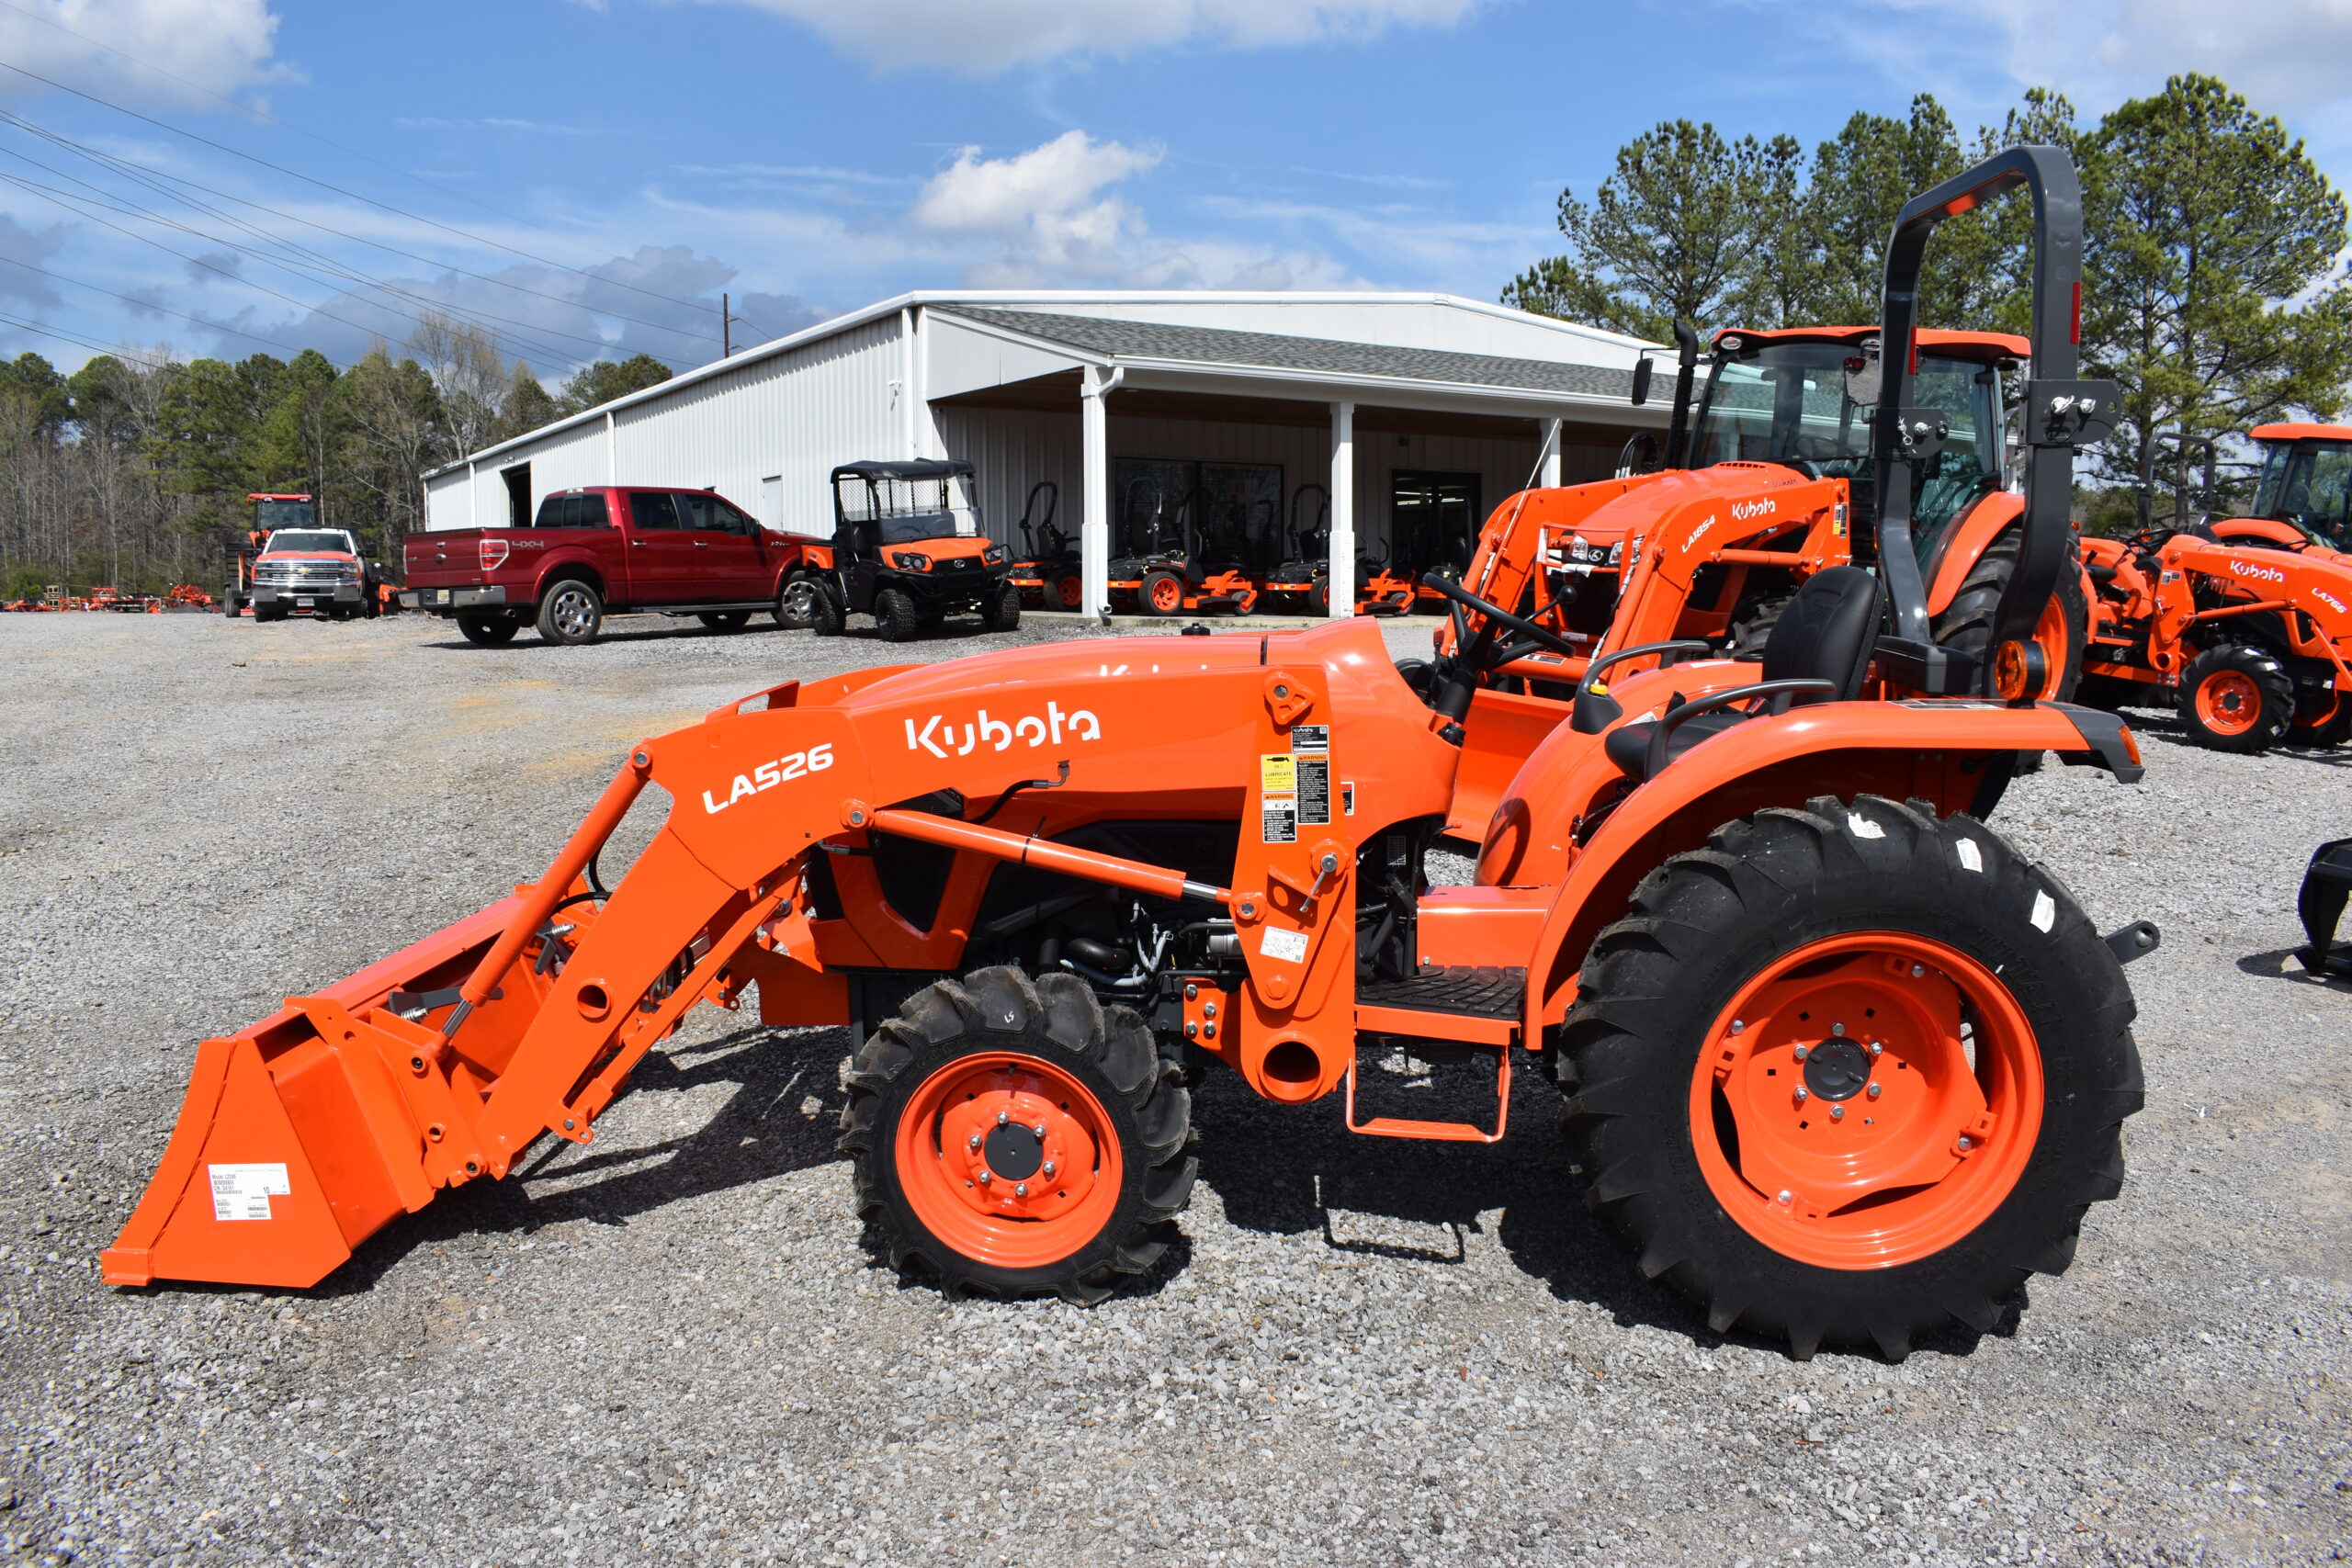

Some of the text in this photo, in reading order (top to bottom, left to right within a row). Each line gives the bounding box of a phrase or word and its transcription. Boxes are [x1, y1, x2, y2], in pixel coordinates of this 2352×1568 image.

[1732, 497, 1776, 521] Kubota
[1681, 514, 1715, 554] LA1854
[2230, 559, 2285, 583] Kubota
[2311, 587, 2347, 614] LA766
[905, 702, 1101, 759] Kubota
[703, 743, 834, 815] LA526
